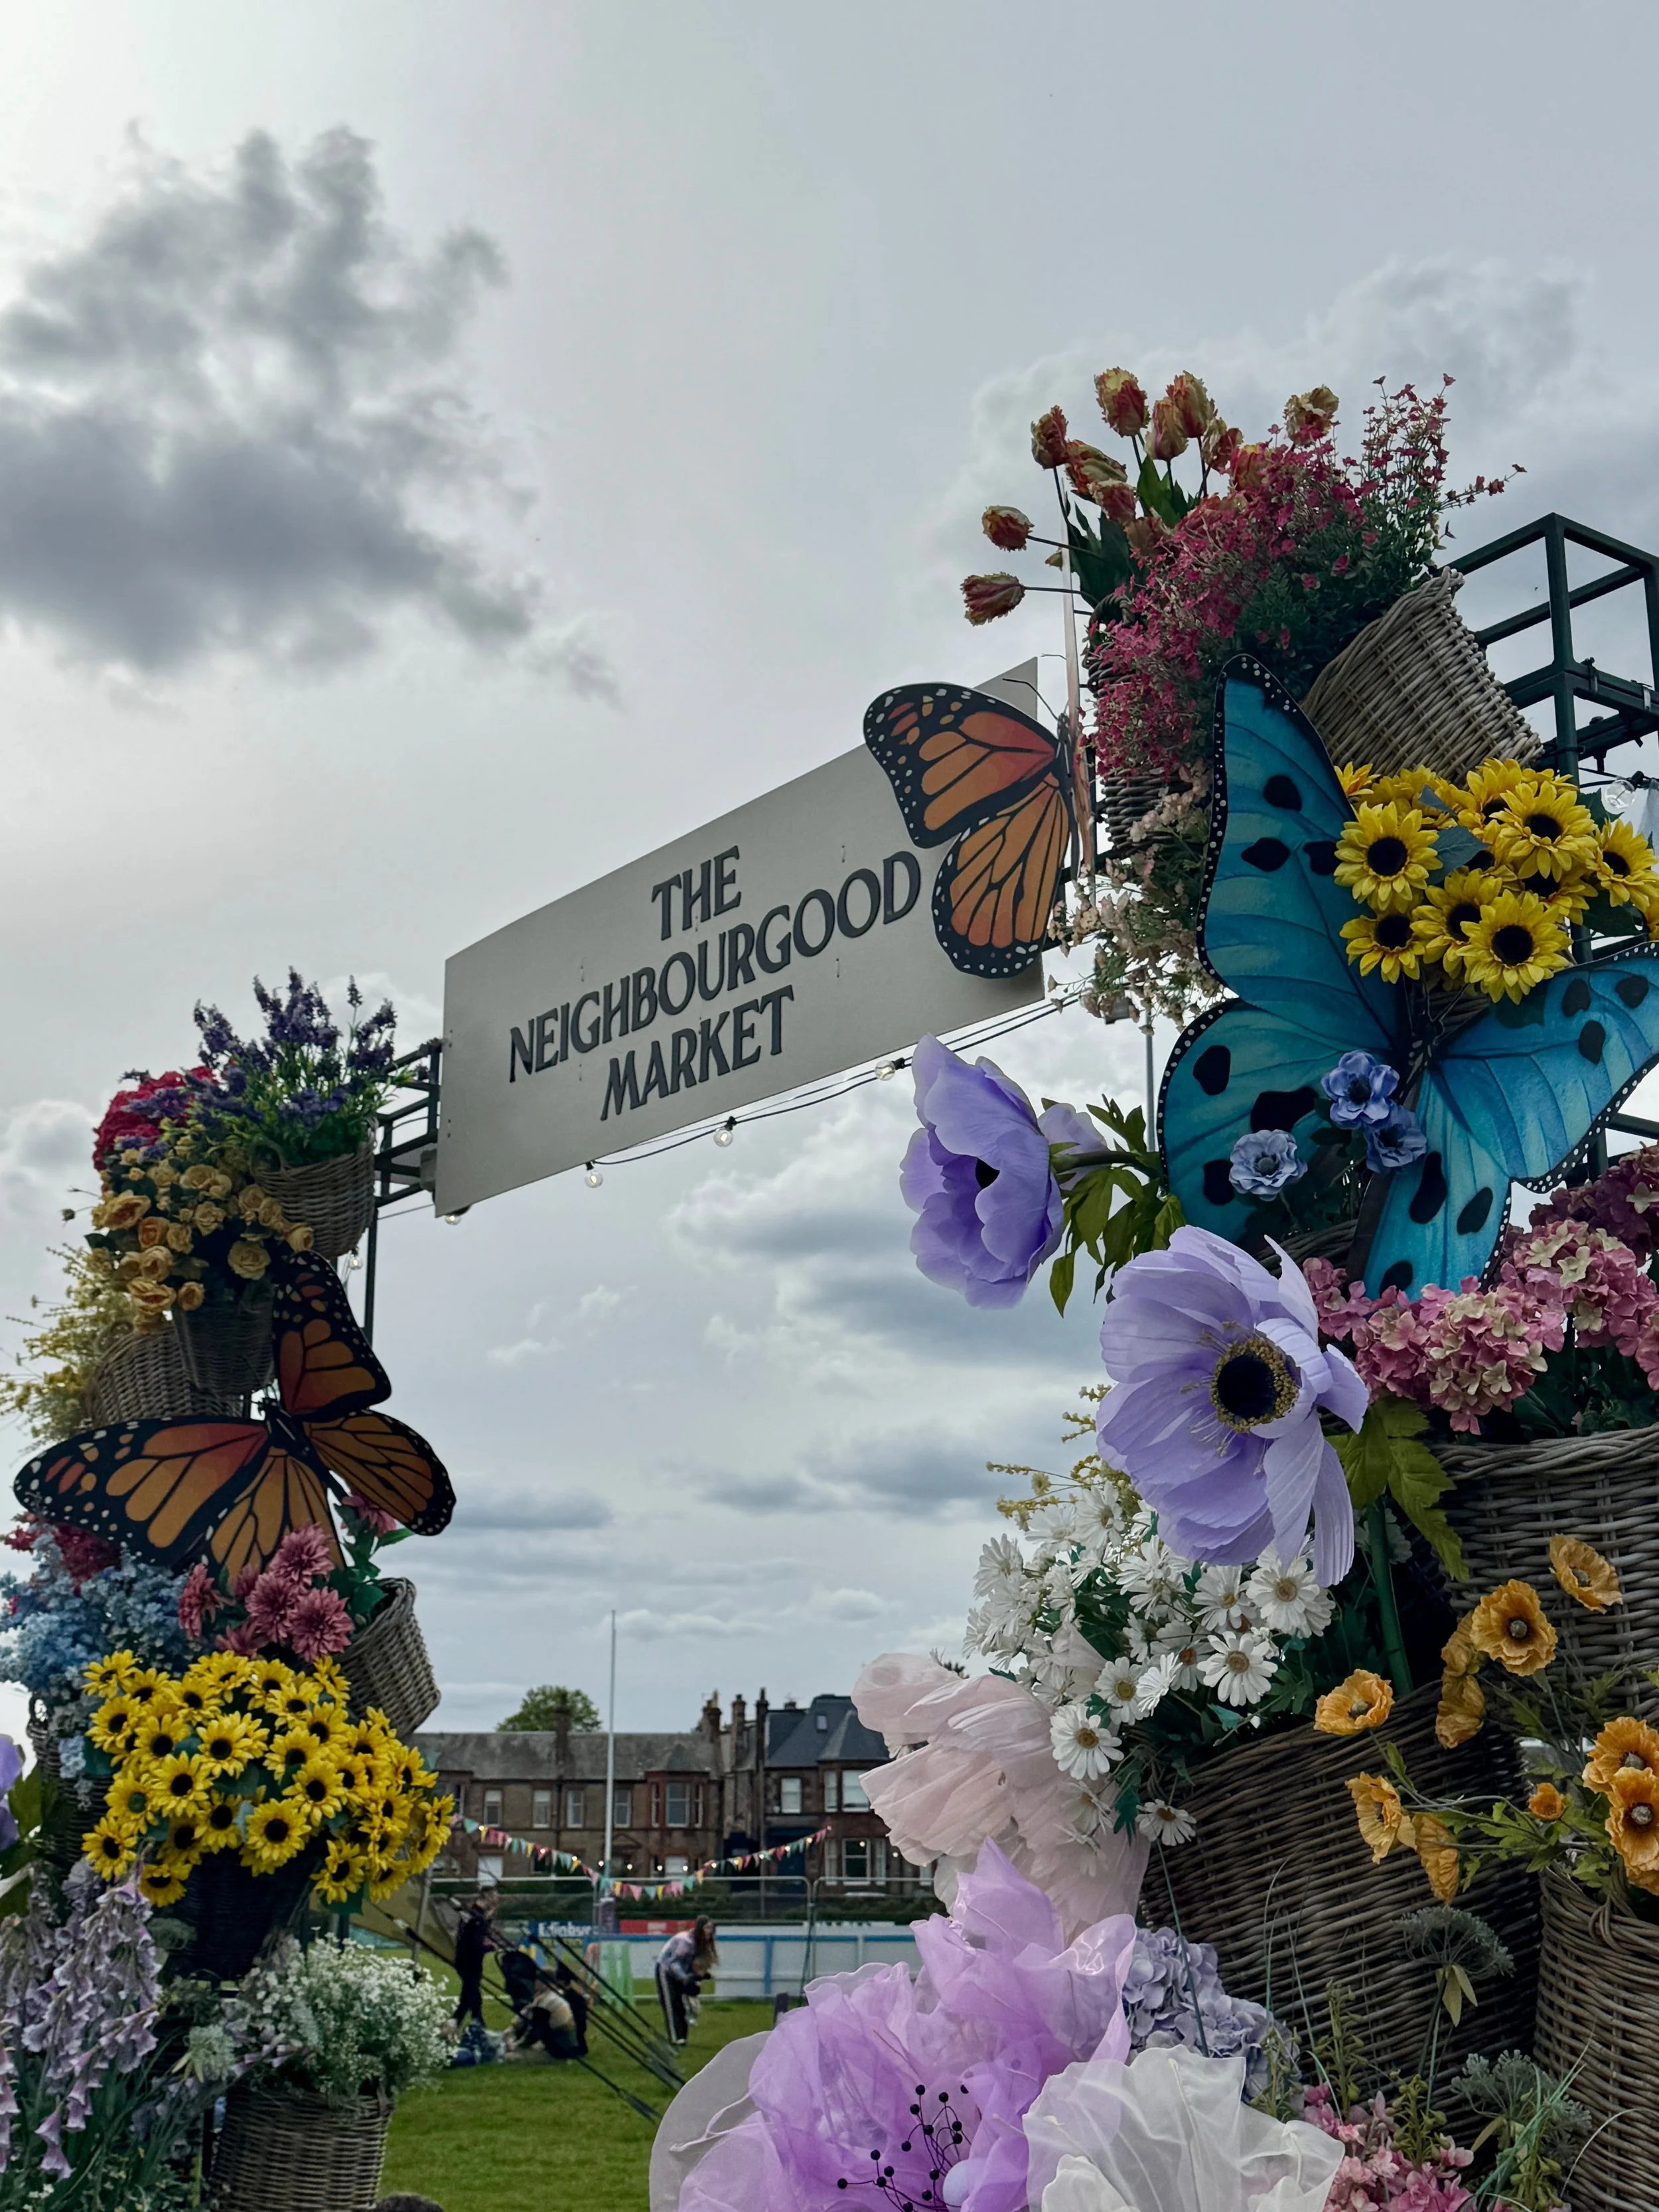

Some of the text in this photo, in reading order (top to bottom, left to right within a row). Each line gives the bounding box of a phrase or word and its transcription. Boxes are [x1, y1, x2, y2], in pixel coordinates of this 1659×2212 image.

[651, 846, 742, 941] THE
[509, 850, 922, 1083] NEIGHBOURGOOD
[600, 985, 794, 1121] MARKET
